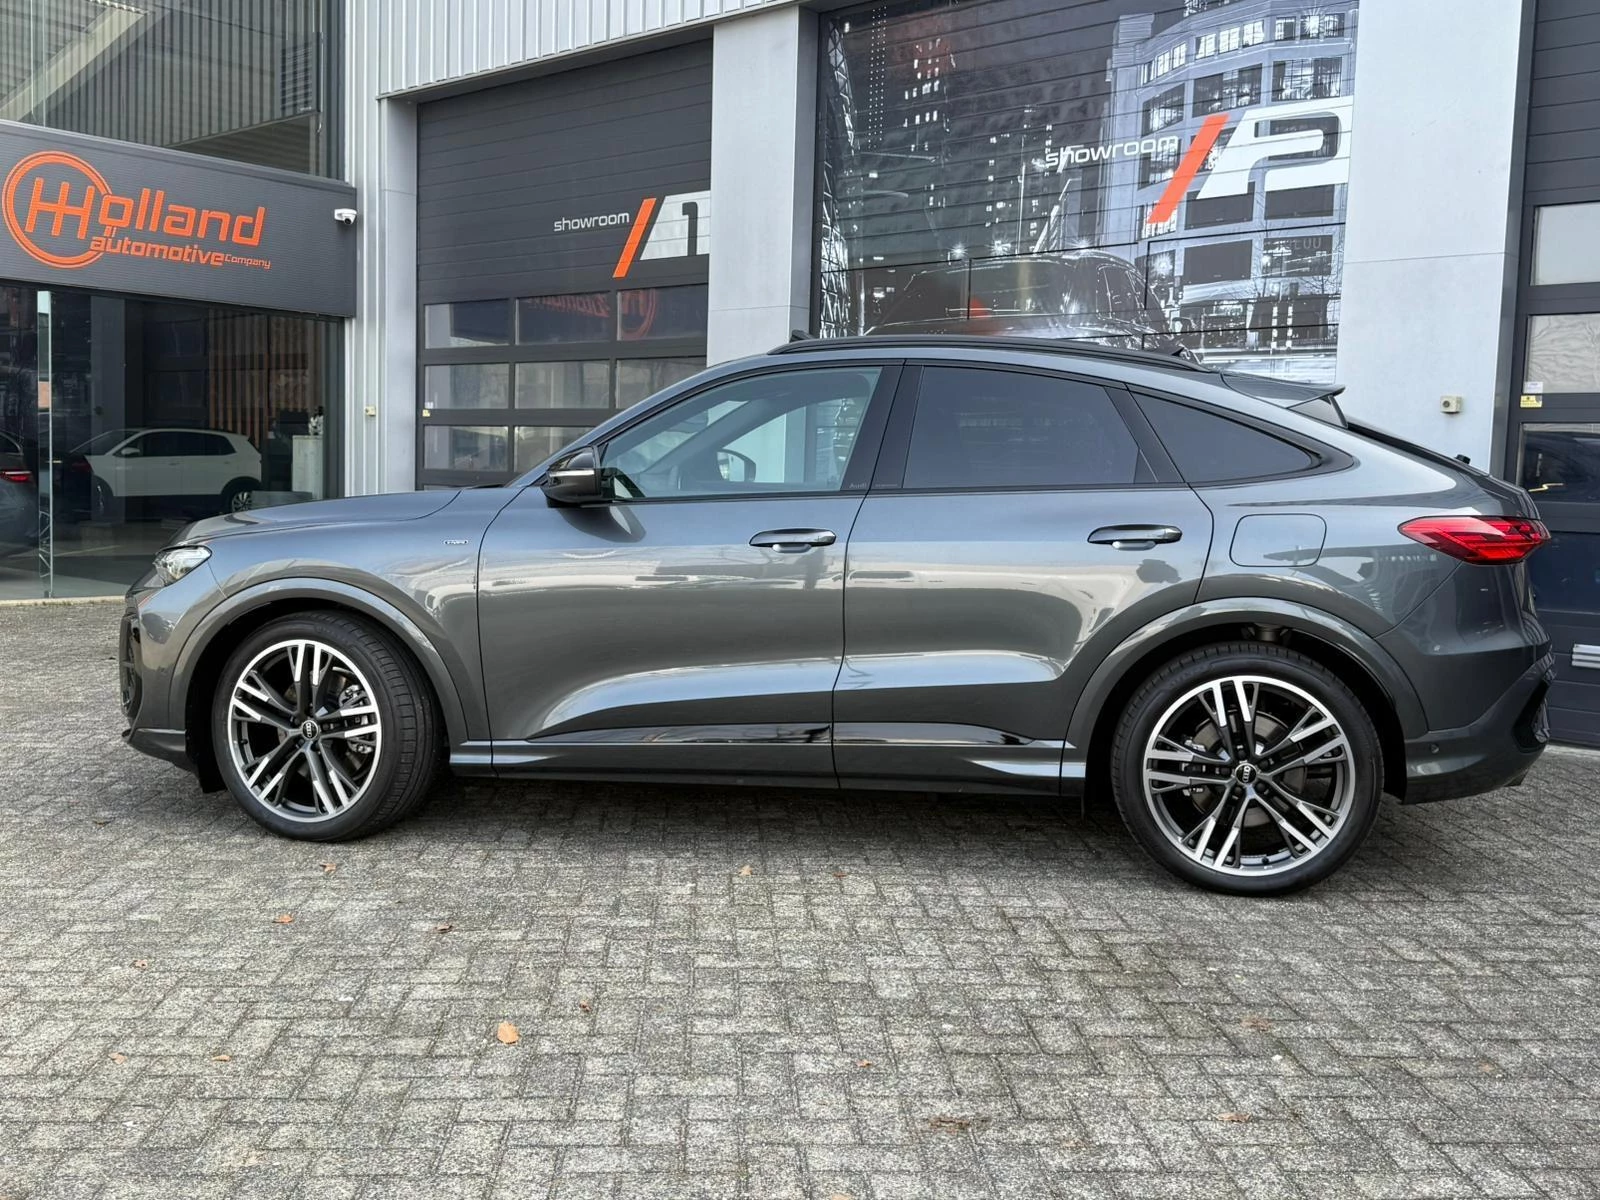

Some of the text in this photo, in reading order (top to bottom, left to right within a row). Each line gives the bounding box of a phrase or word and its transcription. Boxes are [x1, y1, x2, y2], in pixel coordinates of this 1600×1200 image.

[1045, 134, 1179, 168] showroom
[553, 212, 630, 232] showroom
[224, 253, 272, 270] Company
